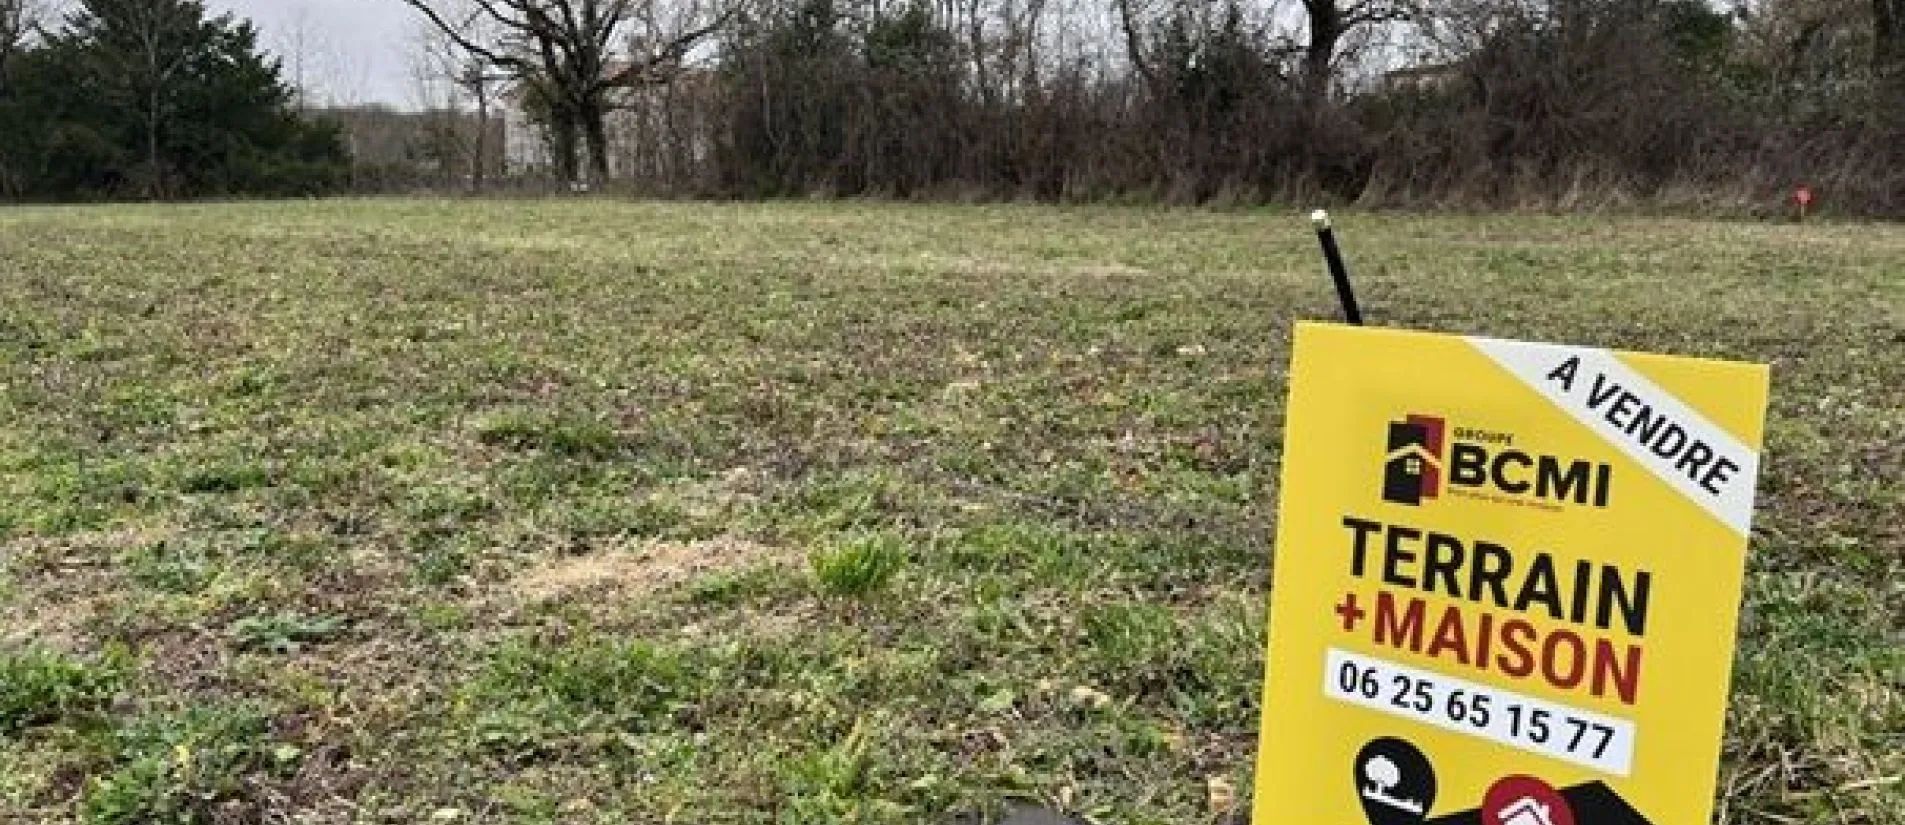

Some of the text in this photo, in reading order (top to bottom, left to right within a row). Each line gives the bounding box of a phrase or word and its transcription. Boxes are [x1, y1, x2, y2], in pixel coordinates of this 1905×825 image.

[1450, 443, 1612, 507] BCMI
[1548, 354, 1740, 498] A VENDRE
[1342, 517, 1652, 636] TERRAIN
[1338, 660, 1616, 759] 06 25 65 15 77
